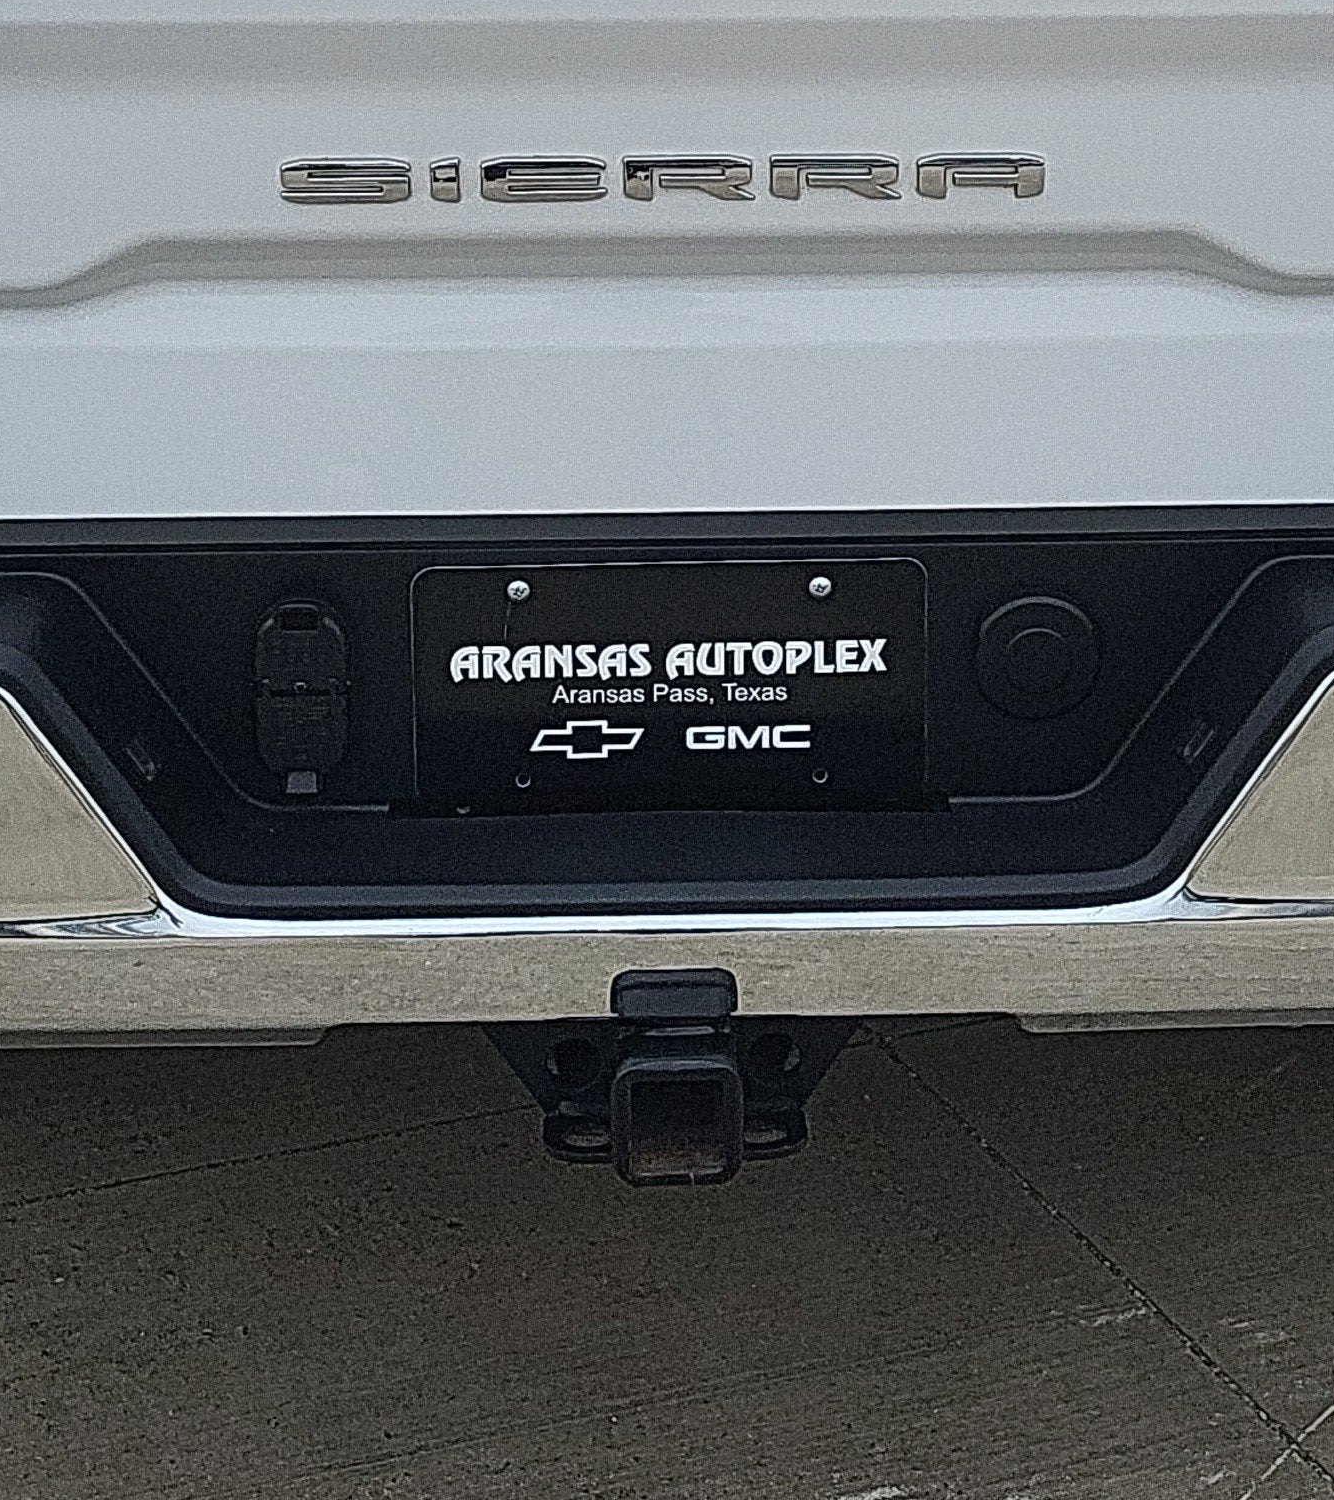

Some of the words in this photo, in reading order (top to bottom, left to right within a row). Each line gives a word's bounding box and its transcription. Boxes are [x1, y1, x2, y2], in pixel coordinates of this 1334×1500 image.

[279, 153, 1045, 204] SIERRA
[450, 643, 652, 683] ARANSAS
[665, 638, 888, 681] AUTOPLEX
[552, 684, 645, 704] Aransas
[652, 684, 715, 705] Pass,
[720, 682, 788, 702] Texas
[685, 724, 811, 750] GMC
